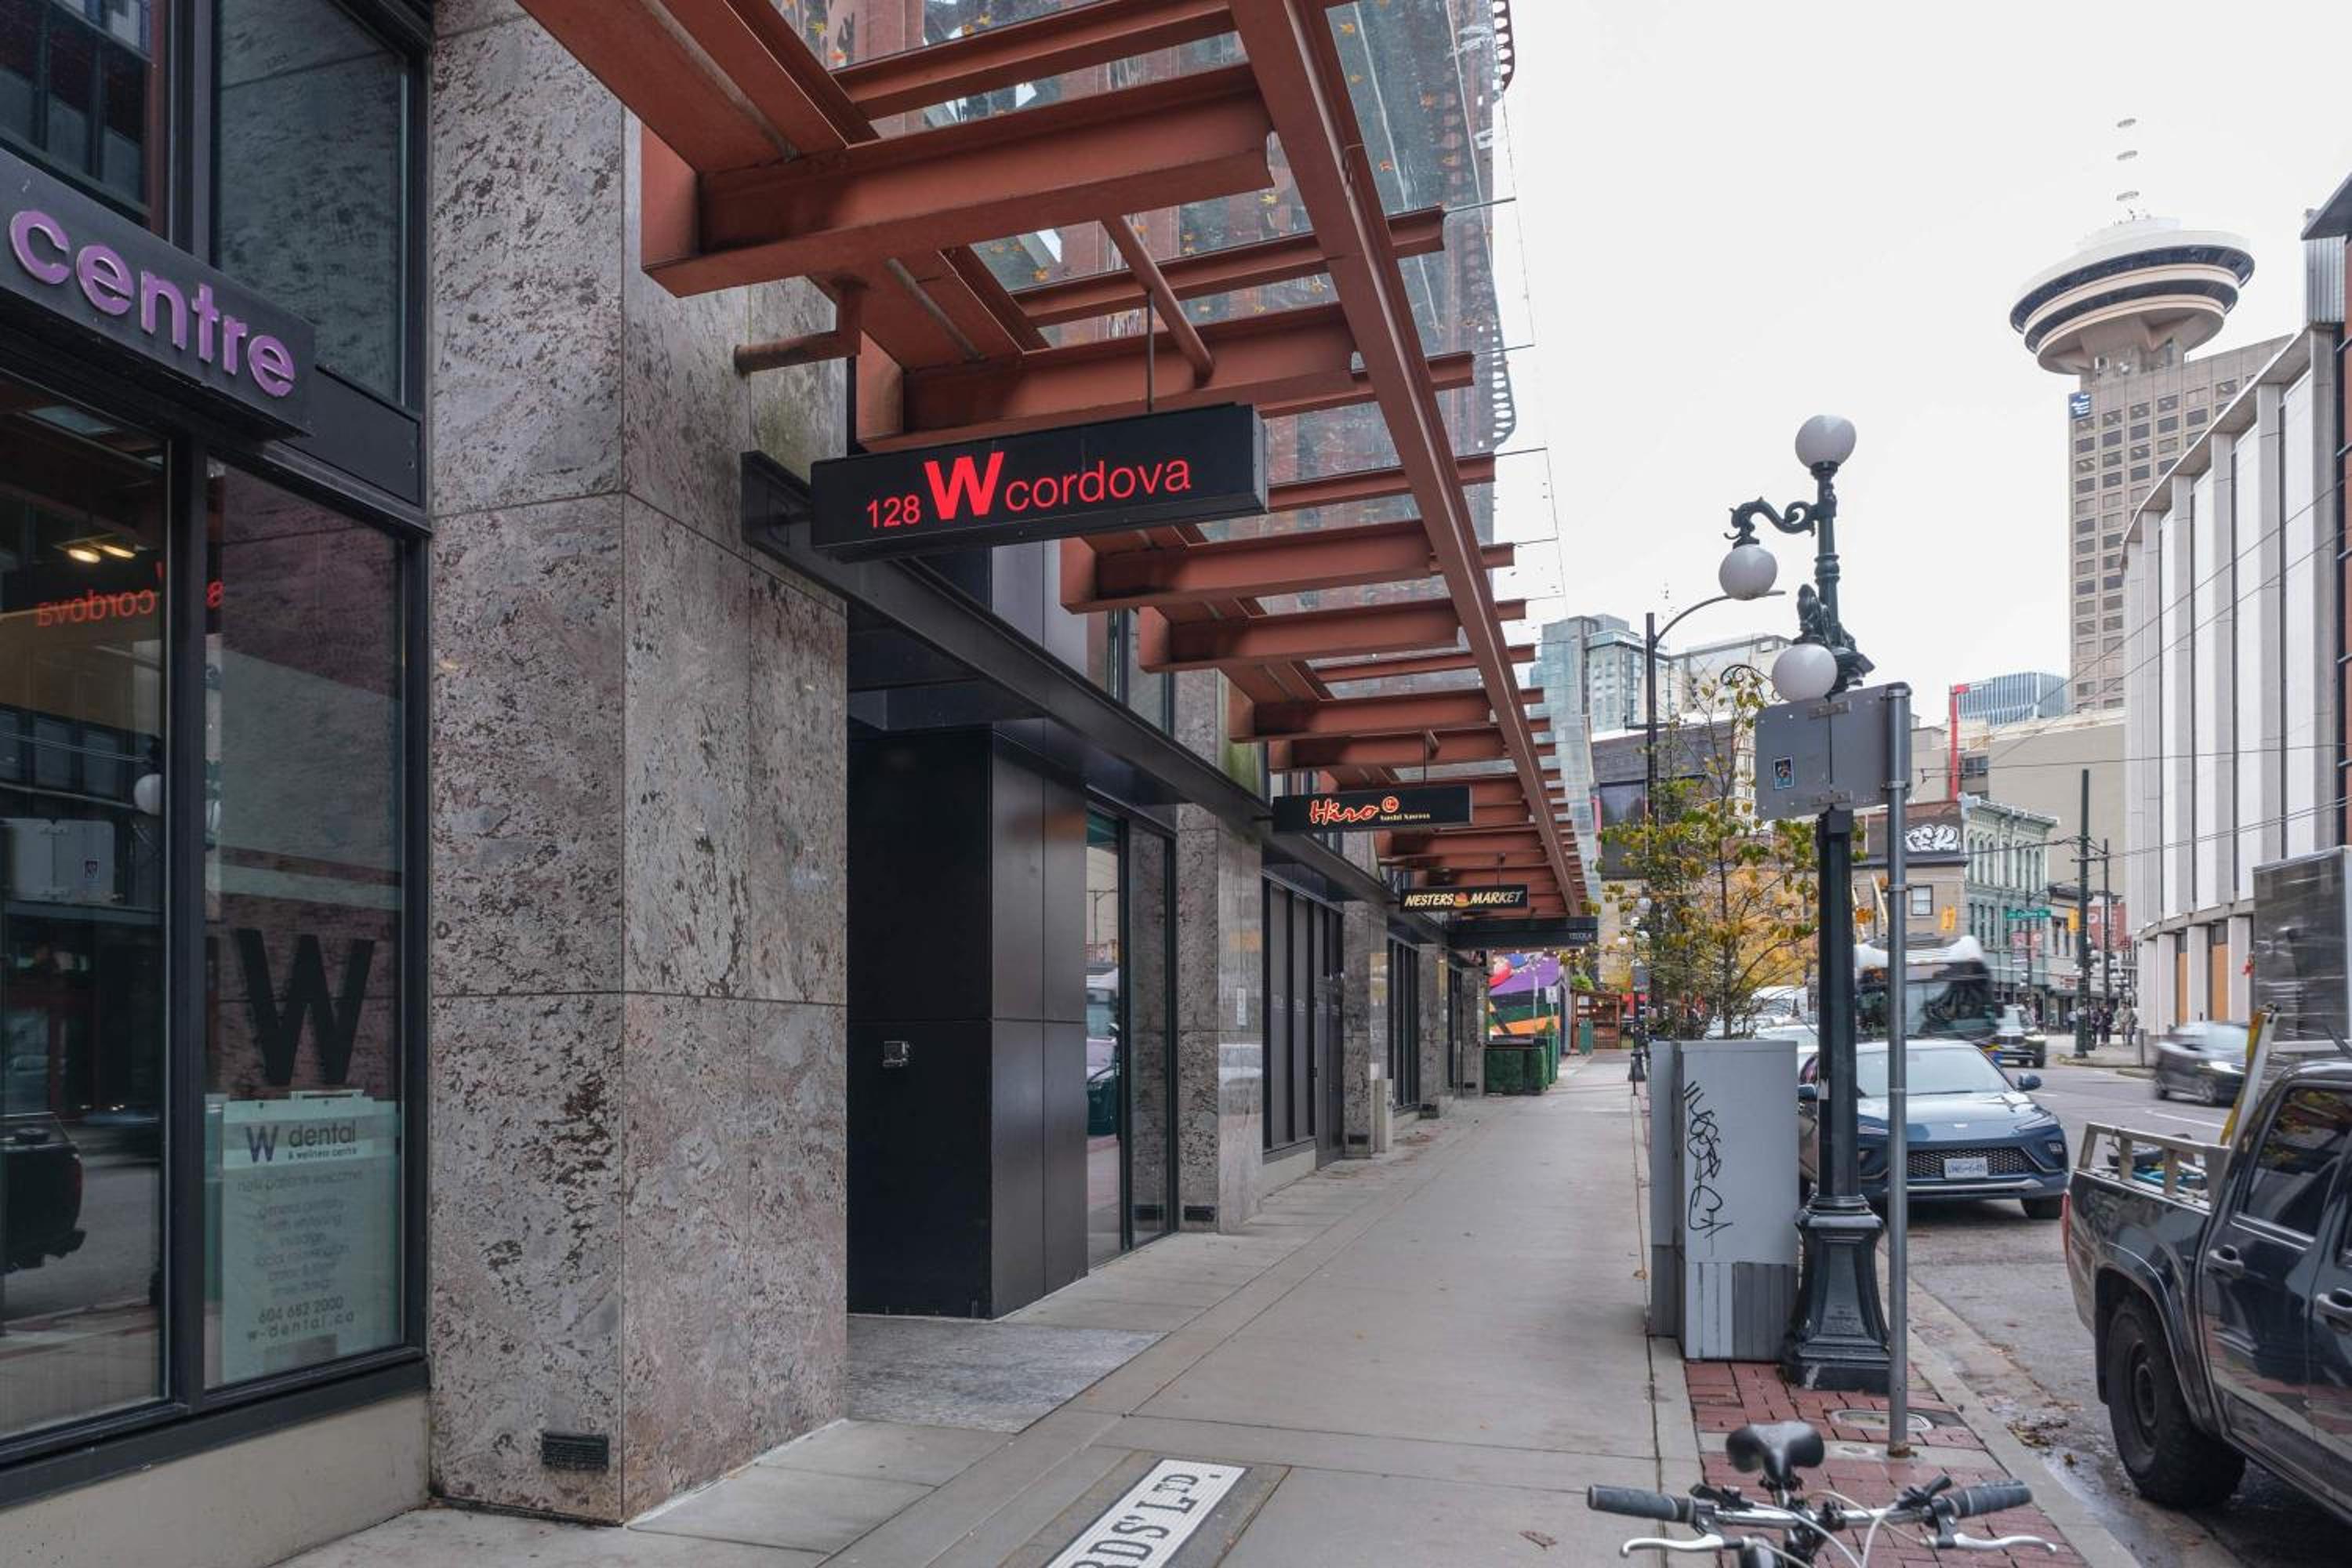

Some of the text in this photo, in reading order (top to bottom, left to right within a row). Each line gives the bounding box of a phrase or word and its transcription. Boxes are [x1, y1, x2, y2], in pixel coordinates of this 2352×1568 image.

[9, 210, 296, 397] centre
[866, 451, 1192, 528] 128 W cordova
[1404, 890, 1523, 907] NESTERS MARKET
[231, 928, 376, 1086] W
[289, 1120, 357, 1147] dental
